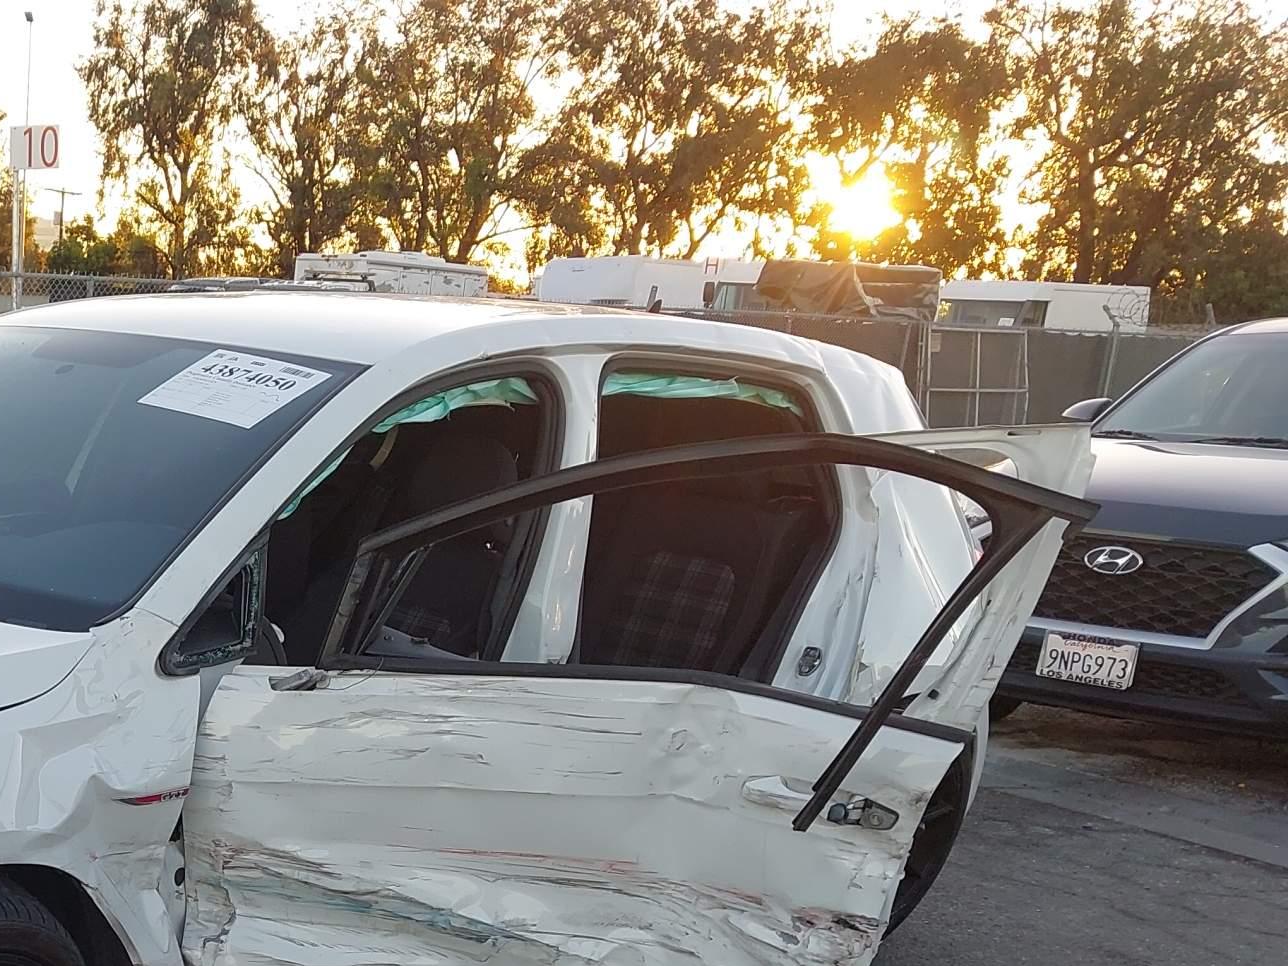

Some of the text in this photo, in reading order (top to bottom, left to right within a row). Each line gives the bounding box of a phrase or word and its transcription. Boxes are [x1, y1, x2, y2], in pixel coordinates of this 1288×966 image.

[23, 125, 59, 168] 10
[200, 363, 298, 391] 43874050
[1067, 632, 1116, 646] HONDA
[1046, 648, 1129, 680] 9NPG973
[1039, 668, 1124, 690] LOS ANGELES
